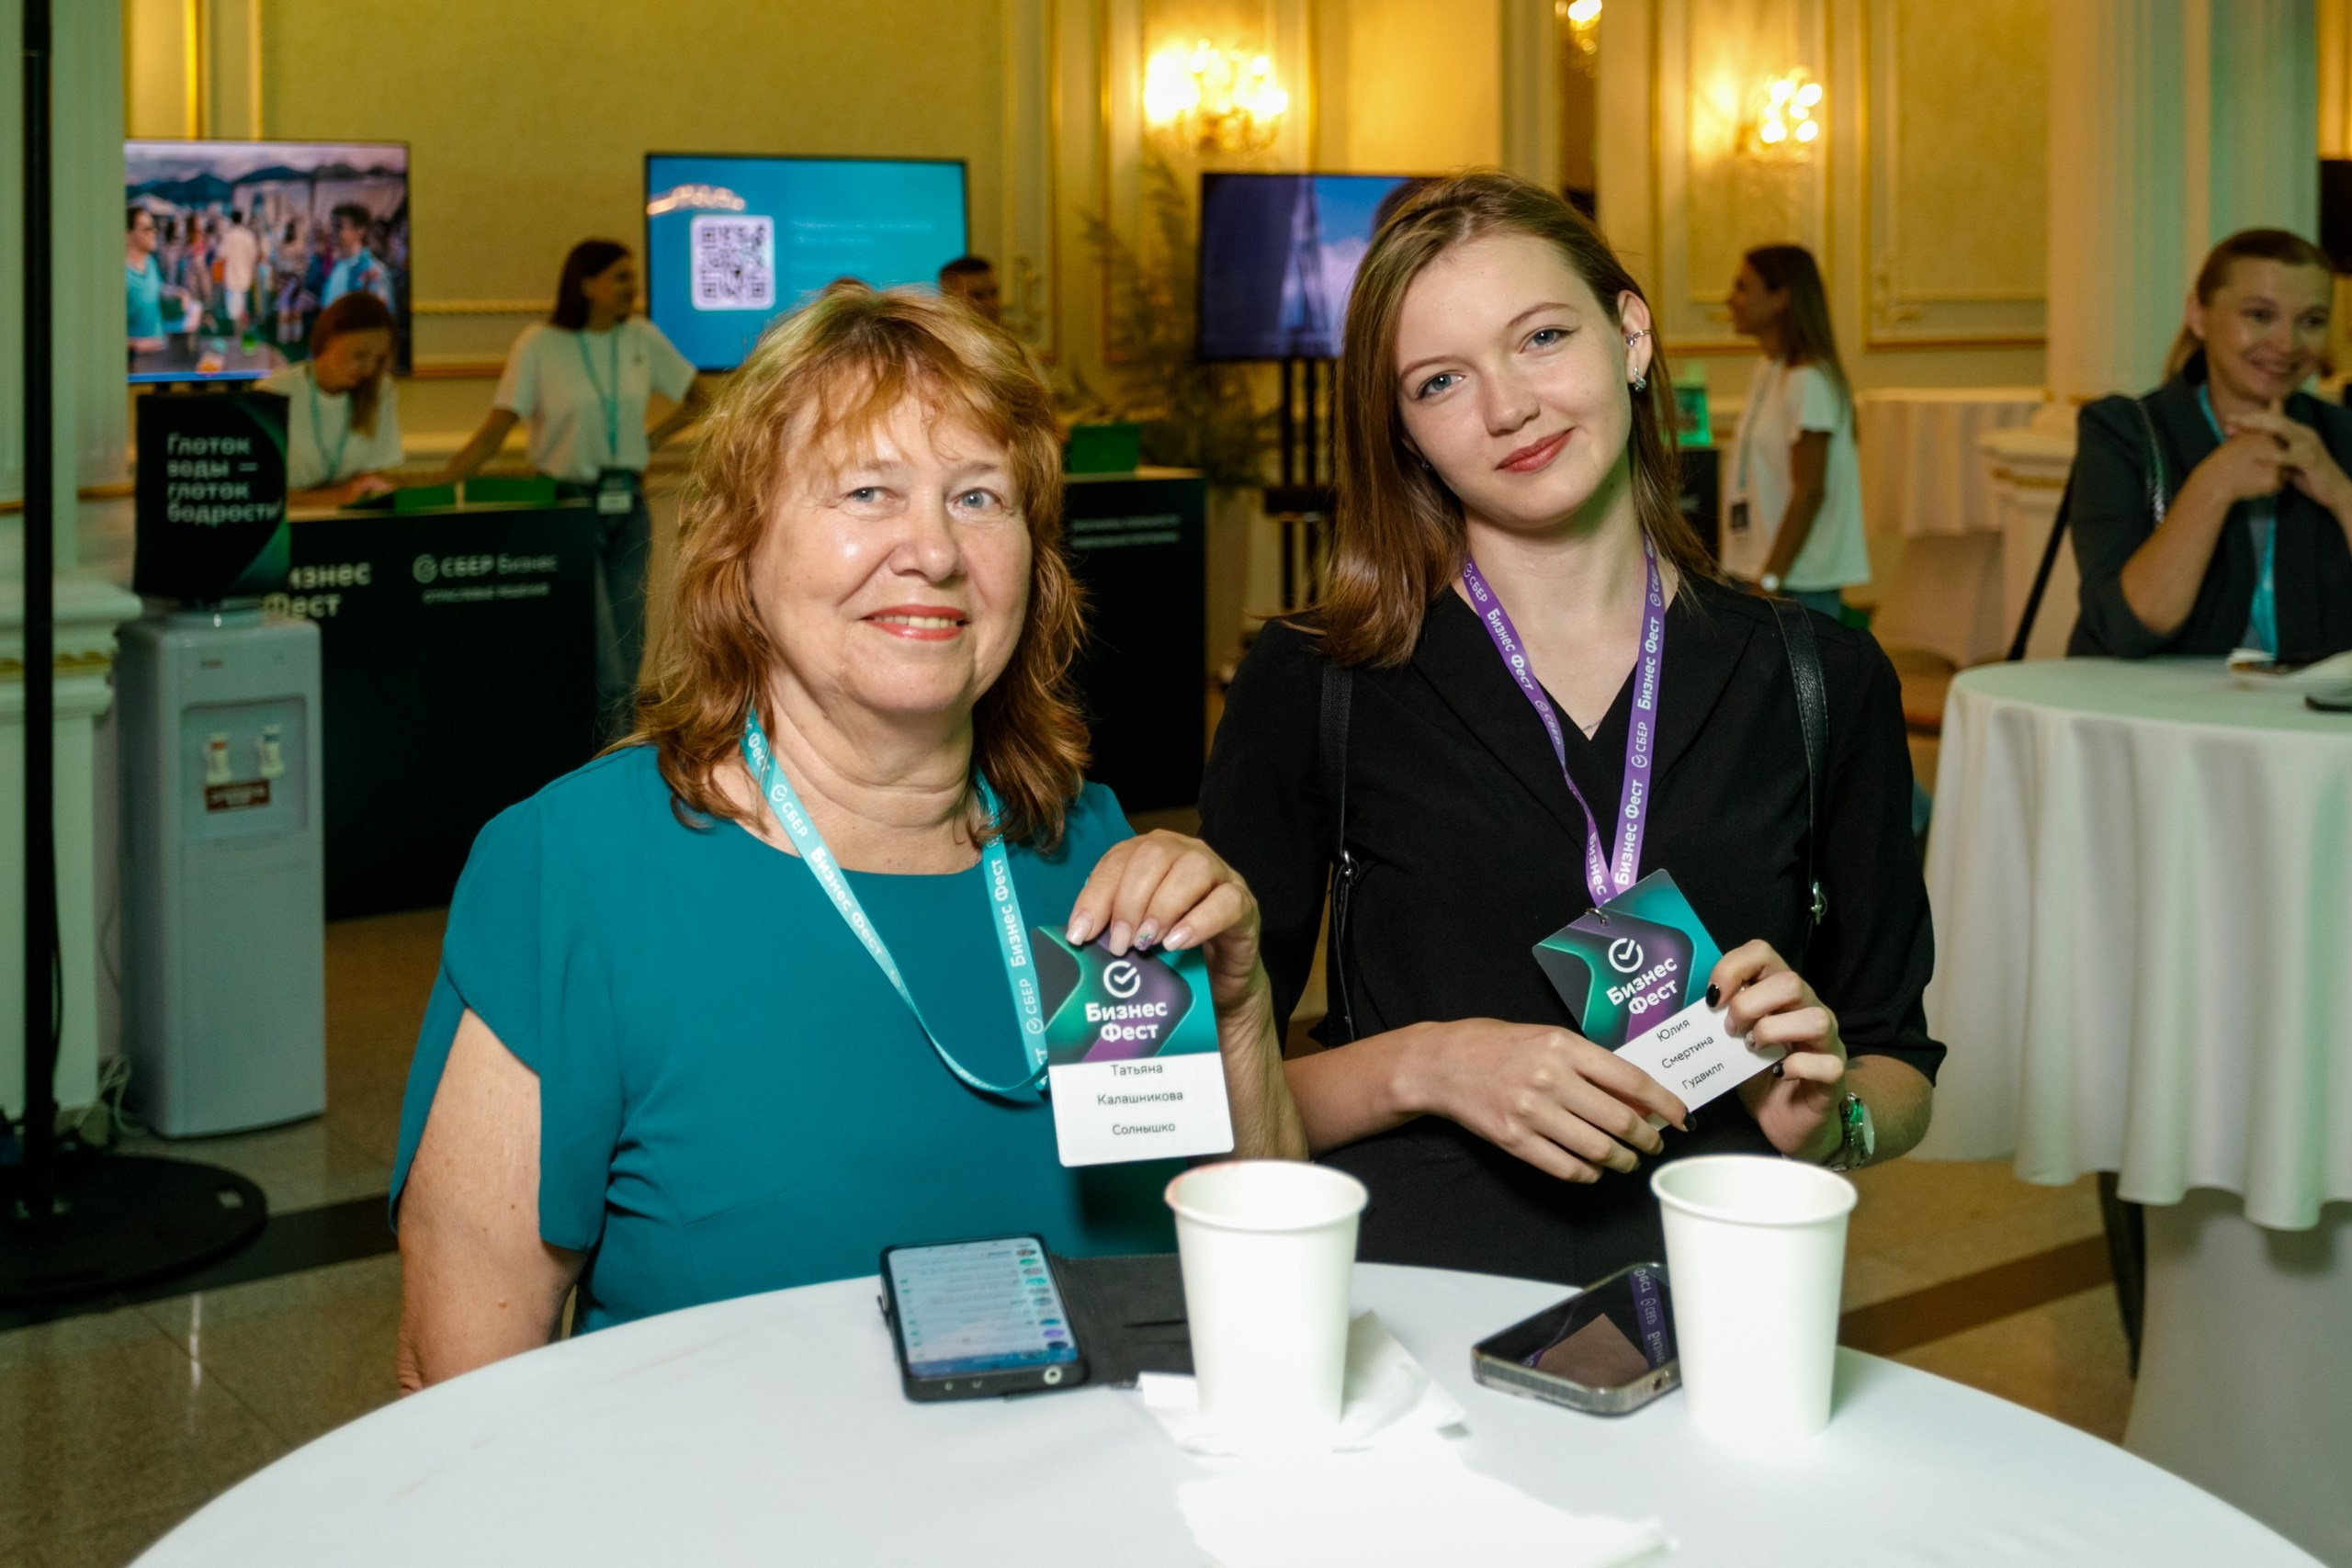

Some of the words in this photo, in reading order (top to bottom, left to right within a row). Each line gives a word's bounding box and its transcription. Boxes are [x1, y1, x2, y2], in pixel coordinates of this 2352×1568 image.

[167, 432, 251, 455] Глоток
[167, 459, 229, 479] воды
[167, 482, 250, 500] глоток
[288, 562, 372, 590] изнес
[441, 555, 495, 577] СБЕР
[1468, 575, 1487, 603] СБЕР
[1487, 608, 1516, 652] Бизнес
[1510, 654, 1534, 691] Фест
[1645, 616, 1660, 654] Фест
[1637, 657, 1656, 710] Бизнес
[1636, 722, 1648, 752] СБЕР
[1624, 779, 1644, 818] Фест
[1589, 831, 1607, 896] Бизнес
[1614, 823, 1637, 886] Бизнес
[782, 802, 808, 837] СБЕР
[810, 846, 853, 911] Бизнес
[852, 911, 883, 955] Фест
[991, 859, 1009, 902] Фест
[1001, 904, 1026, 967] Бизнес
[1019, 978, 1037, 1014] СБЕР
[1606, 956, 1678, 1006] Бизнес
[1628, 979, 1678, 1015] Фест
[1085, 1002, 1168, 1022] Бизнес
[1101, 1022, 1159, 1043] Фест
[1657, 1019, 1690, 1043] Юлия
[1662, 1035, 1713, 1069] Смертина
[1111, 1064, 1163, 1077] Татьяна
[1681, 1061, 1724, 1089] Гудвилл
[1098, 1091, 1183, 1105] Калашникова
[1113, 1122, 1175, 1135] Солнышко
